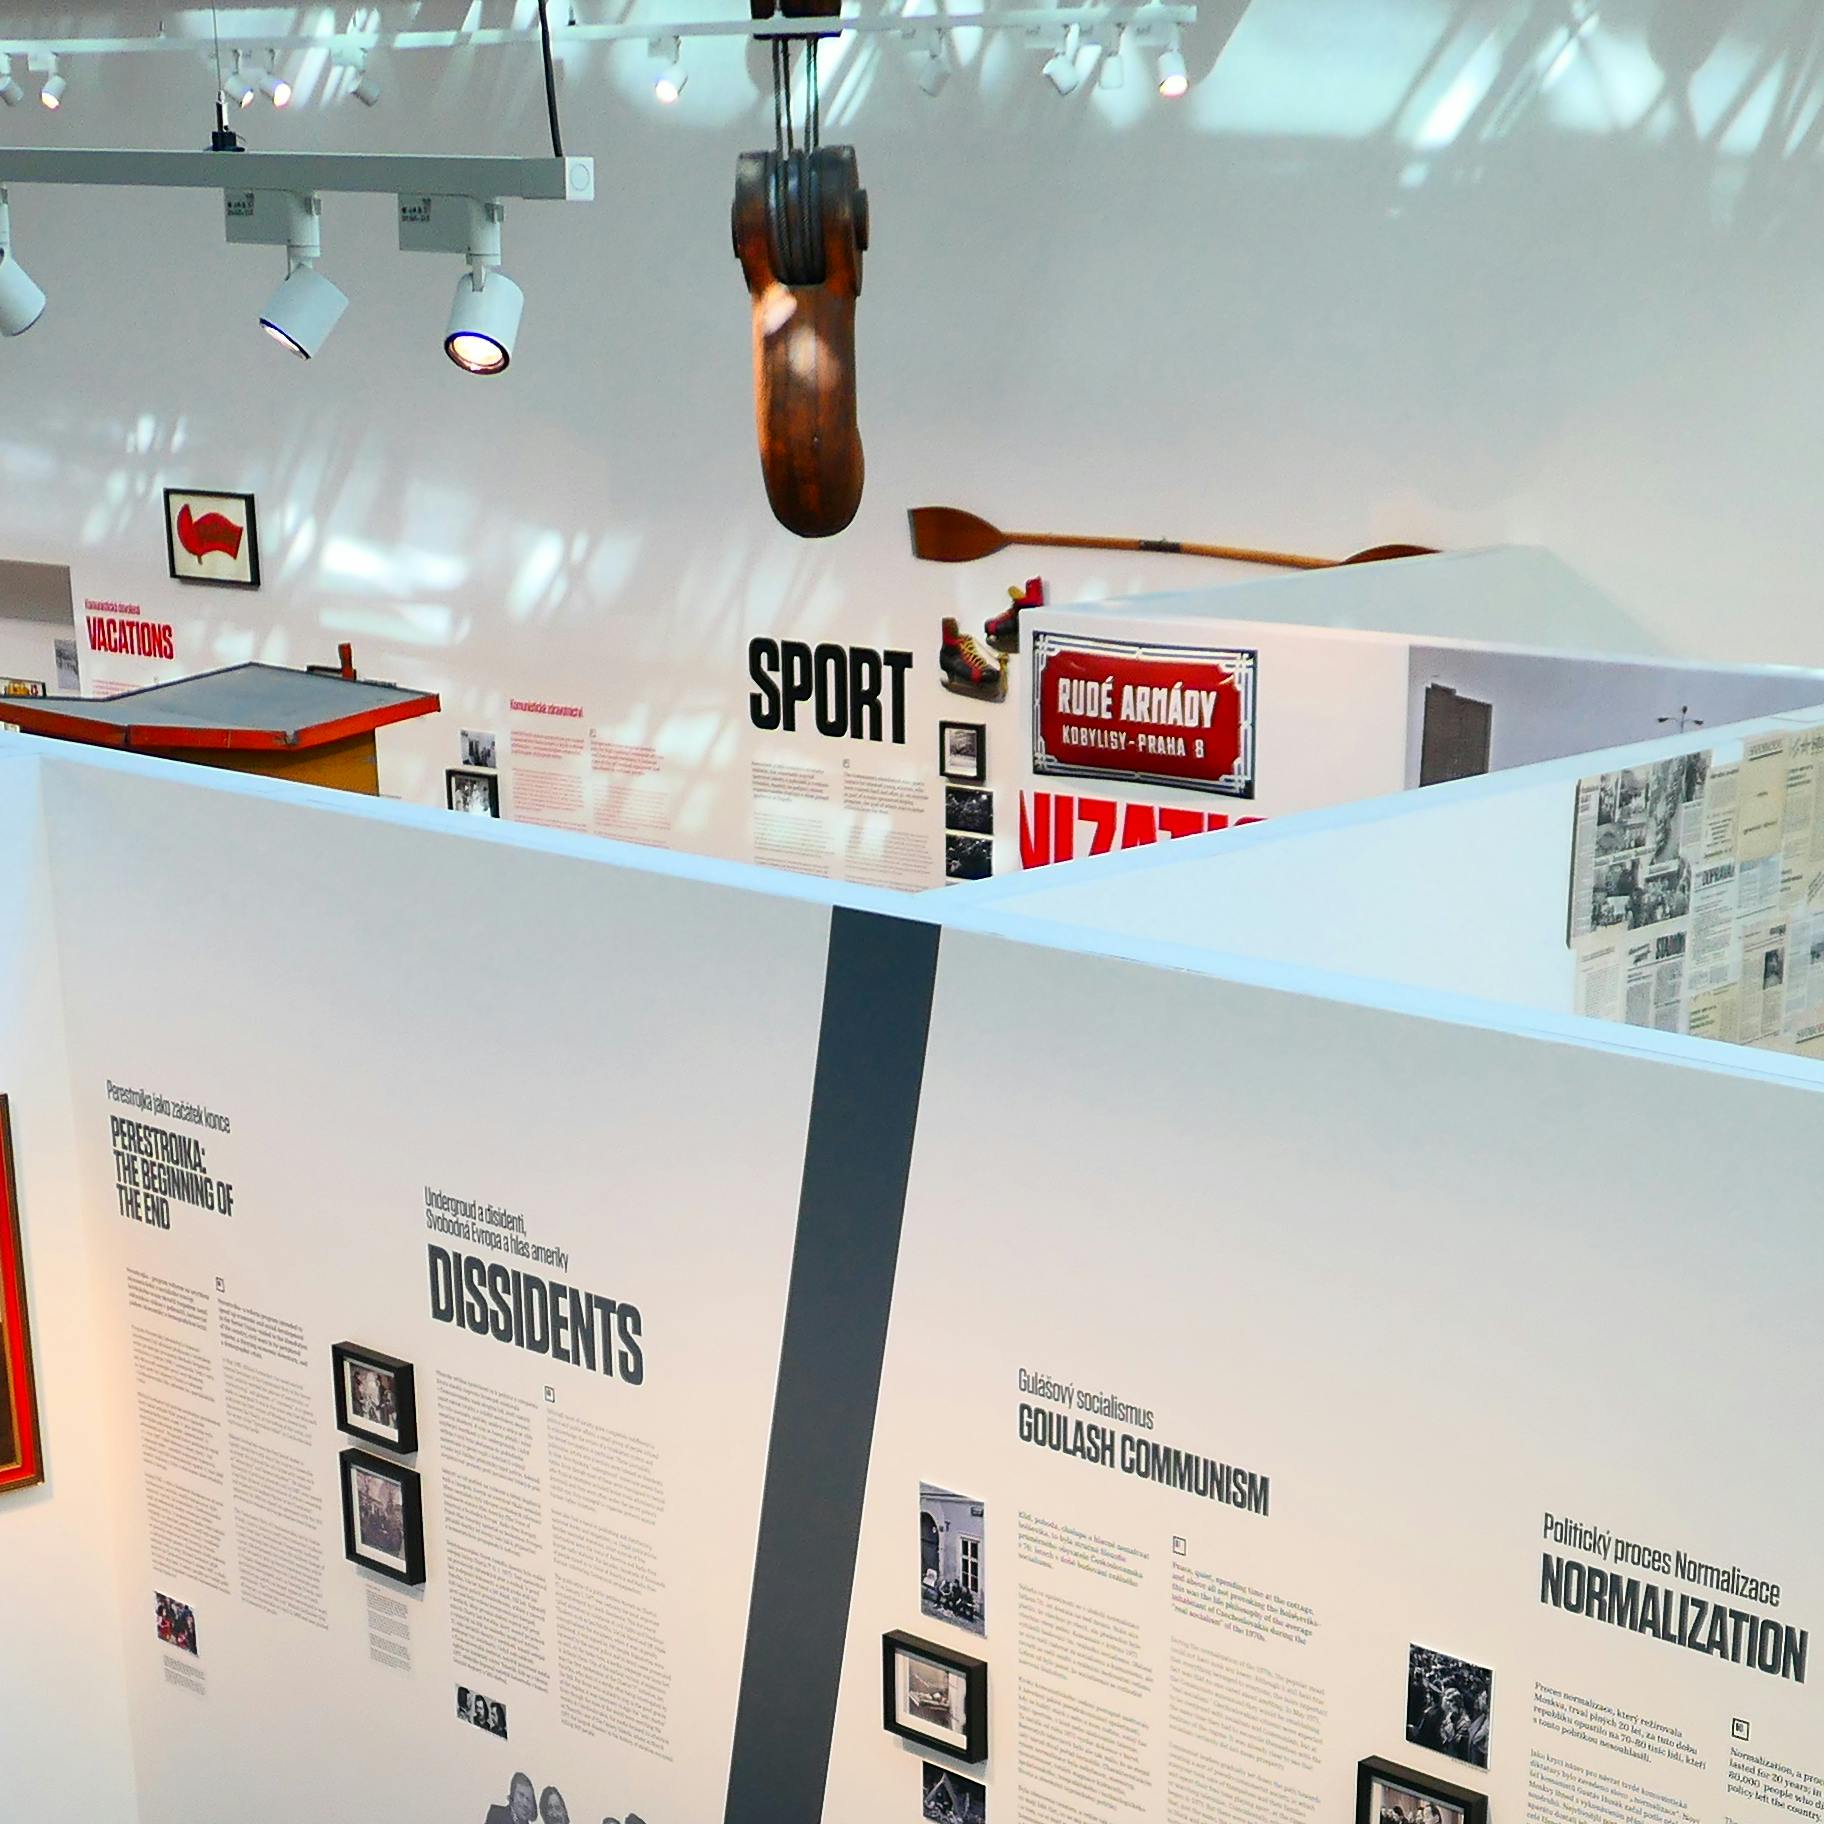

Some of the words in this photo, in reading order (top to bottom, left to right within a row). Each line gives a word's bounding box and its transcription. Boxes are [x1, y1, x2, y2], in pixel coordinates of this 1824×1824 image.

[85, 615, 174, 660] VACATIONS
[749, 637, 914, 745] SPORT
[1057, 676, 1113, 719] RUDÉ
[1120, 682, 1217, 729] ARMÁDY
[1194, 739, 1205, 758] 8
[107, 1080, 152, 1112] Perestrojka
[153, 1092, 170, 1116] jako
[171, 1101, 203, 1126] začátek
[204, 1106, 231, 1133] konce
[110, 1115, 207, 1174] PERESTROIKA:
[113, 1150, 139, 1187] THE
[141, 1158, 215, 1211] BEGINNING
[216, 1181, 234, 1217] OF
[116, 1183, 142, 1222] THE
[143, 1192, 170, 1230] END
[426, 1209, 471, 1241] Svobodná
[472, 1221, 502, 1251] Evropa
[503, 1235, 510, 1251] a
[510, 1233, 530, 1259] hlas
[478, 1206, 484, 1222] a
[428, 1243, 644, 1386] DISSIDENTS
[1018, 1367, 1075, 1409] Gulášový
[1077, 1387, 1154, 1431] socialismus
[1019, 1402, 1115, 1470] GOULASH
[1120, 1434, 1270, 1517] COMMUNISM
[1543, 1511, 1612, 1562] Politický
[1614, 1535, 1672, 1578] proces
[1674, 1550, 1781, 1608] Normalizace
[1540, 1553, 1809, 1684] NORMALIZATION
[1728, 1770, 1759, 1789] 80,000
[1763, 1784, 1792, 1800] people
[1794, 1794, 1813, 1807] who
[1729, 1759, 1755, 1775] lasted
[1757, 1768, 1769, 1780] for
[1784, 1779, 1811, 1796] years;
[1730, 1746, 1793, 1778] Normalization,
[1727, 1785, 1753, 1801] policy
[1755, 1791, 1769, 1804] left
[1771, 1797, 1785, 1809] the
[1787, 1805, 1821, 1822] country.
